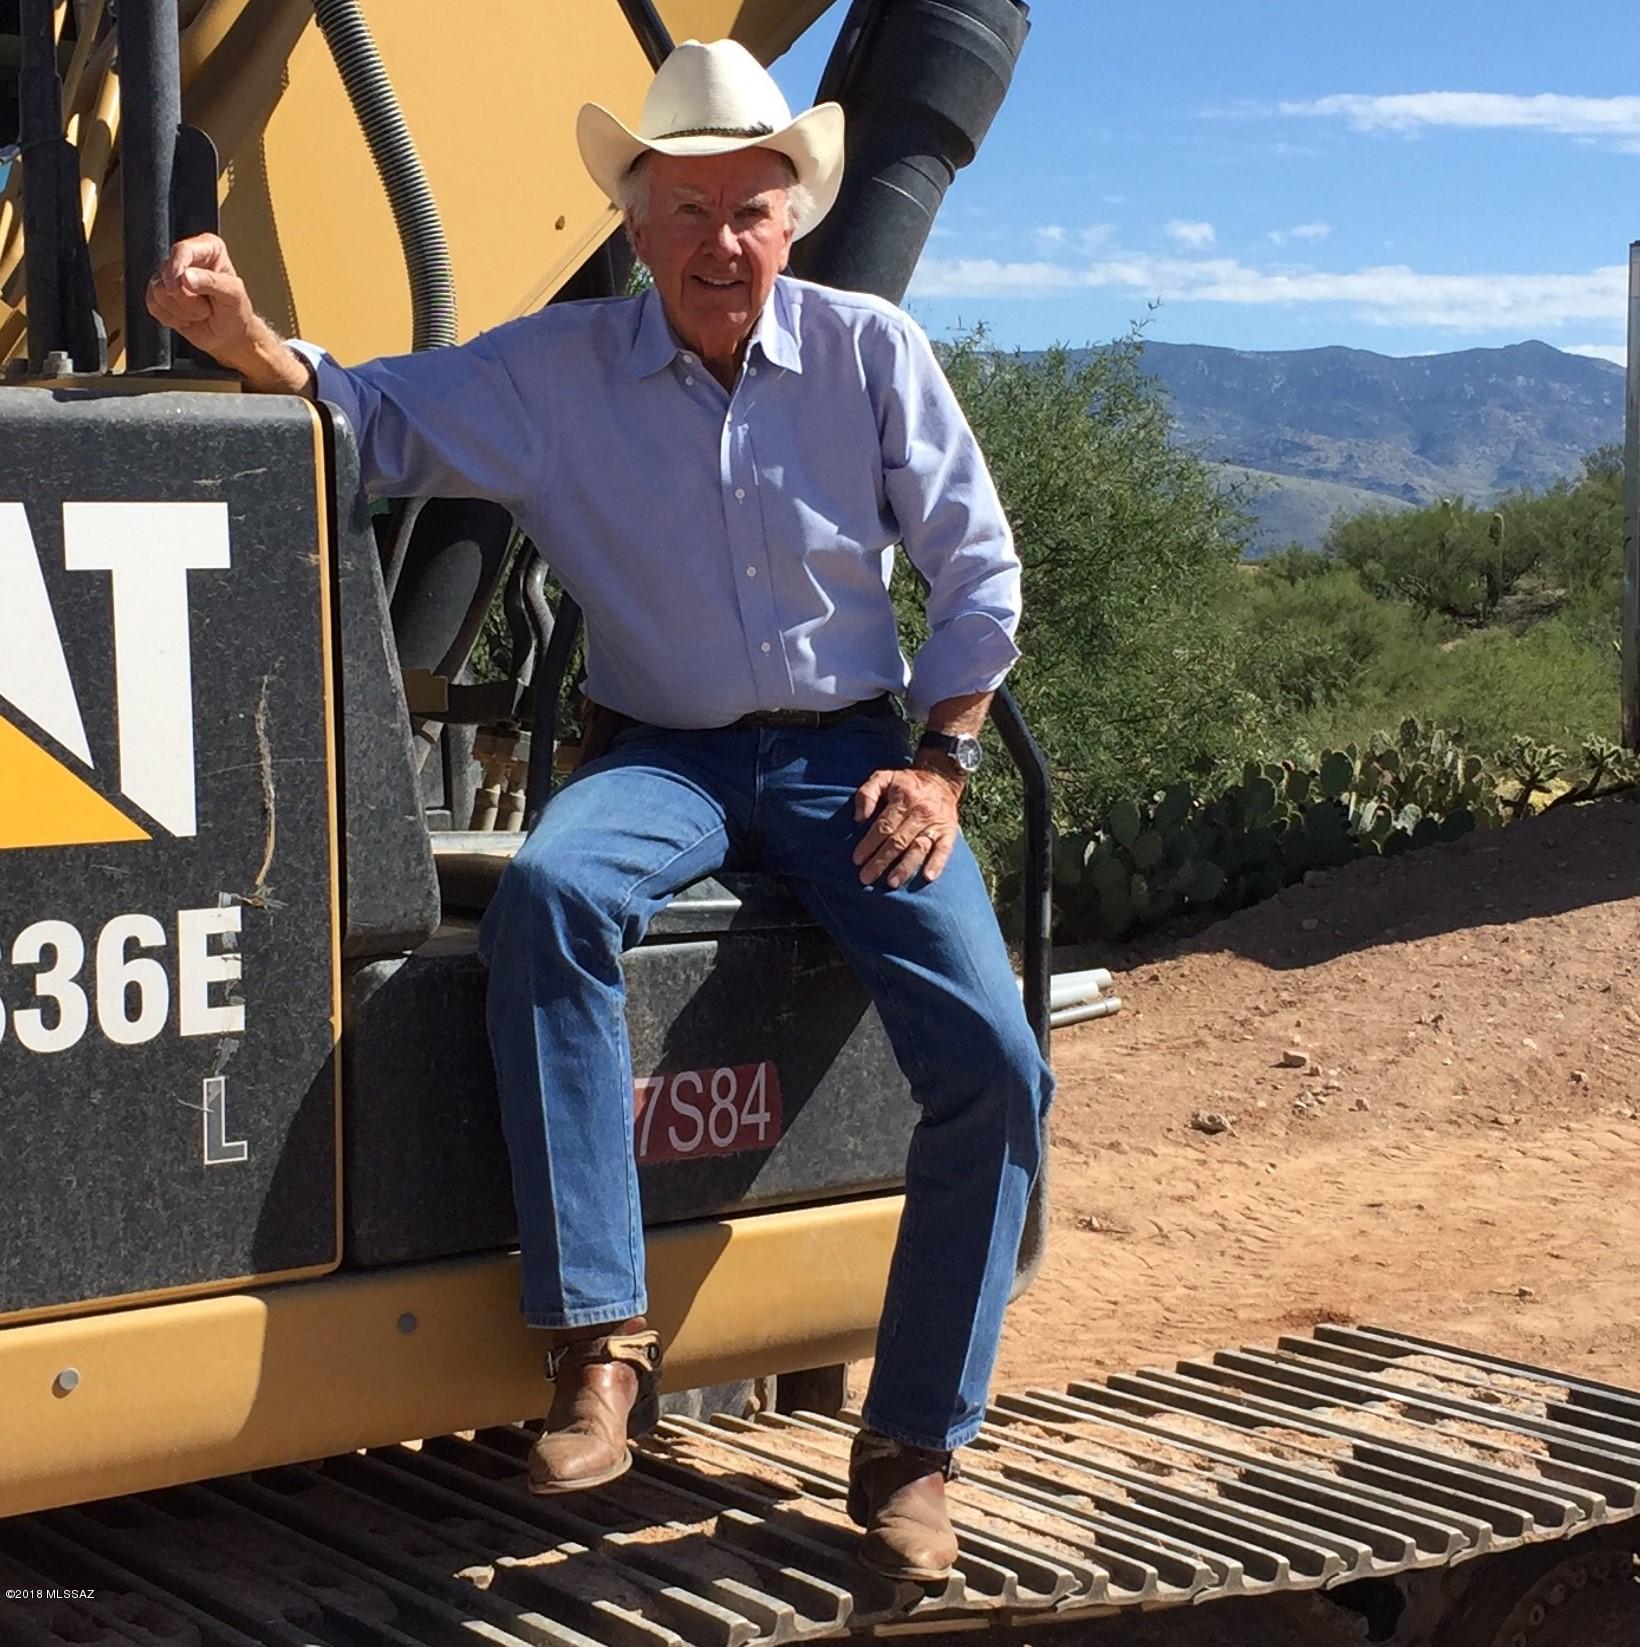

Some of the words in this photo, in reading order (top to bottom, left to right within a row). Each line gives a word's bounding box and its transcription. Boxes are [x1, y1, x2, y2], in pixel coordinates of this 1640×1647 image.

[0, 906, 245, 1053] 36E
[203, 1075, 248, 1164] L
[634, 1062, 771, 1157] 7S84
